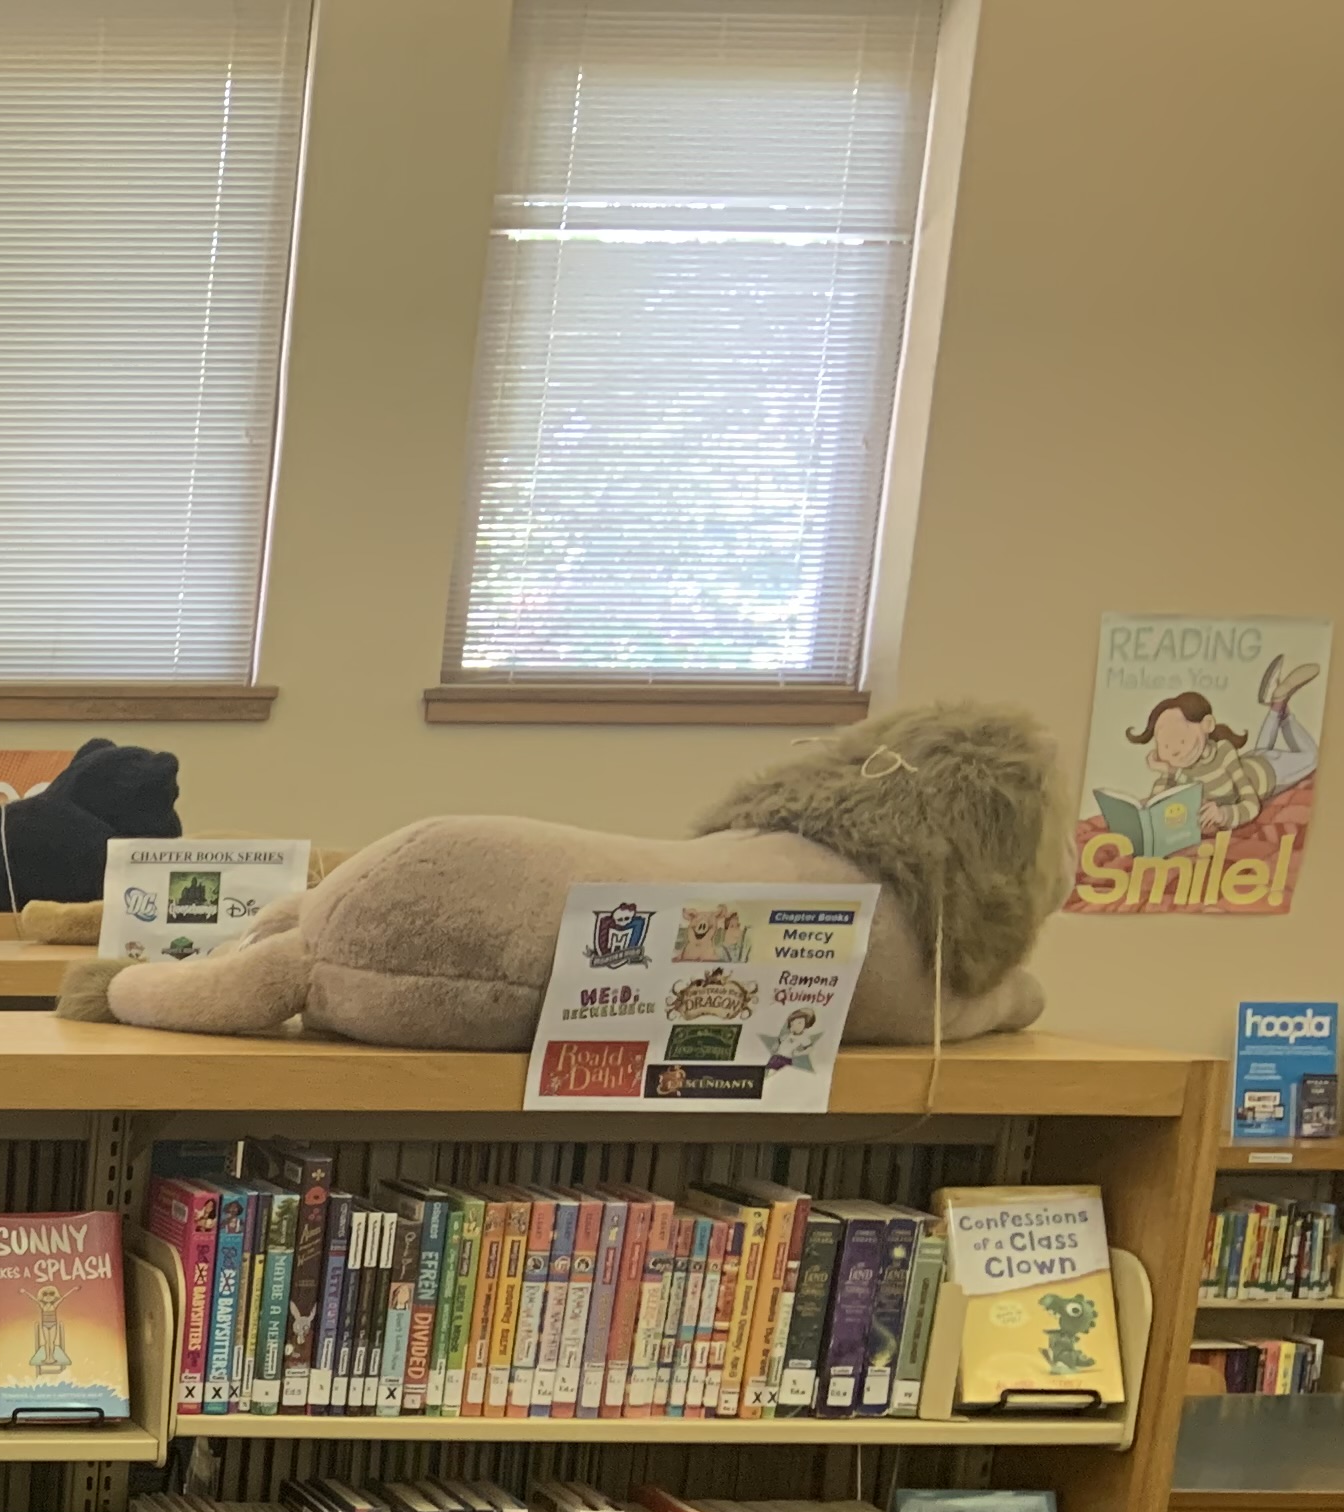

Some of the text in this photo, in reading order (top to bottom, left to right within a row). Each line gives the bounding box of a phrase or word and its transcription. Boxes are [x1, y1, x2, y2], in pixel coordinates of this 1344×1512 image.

[1108, 626, 1263, 663] READING
[1106, 667, 1229, 691] Makes You
[131, 851, 285, 863] CHAPTER BOOK SERIES
[1077, 830, 1296, 906] Smile!
[783, 928, 834, 945] Mercy
[774, 946, 835, 960] Watson
[778, 970, 839, 988] Ramona
[774, 987, 835, 1006] Quimby
[1245, 1008, 1332, 1044] hoopla
[558, 1042, 624, 1072] Roald
[569, 1063, 629, 1091] Dahl
[958, 1207, 1089, 1232] Confessions
[1009, 1230, 1079, 1251] Class
[23, 1267, 32, 1279] A
[33, 1252, 113, 1283] SPLASH
[984, 1255, 1078, 1279] Clown
[187, 1286, 204, 1350] BABYSITTERS
[408, 1251, 438, 1379] EFRÉN DIVIDED
